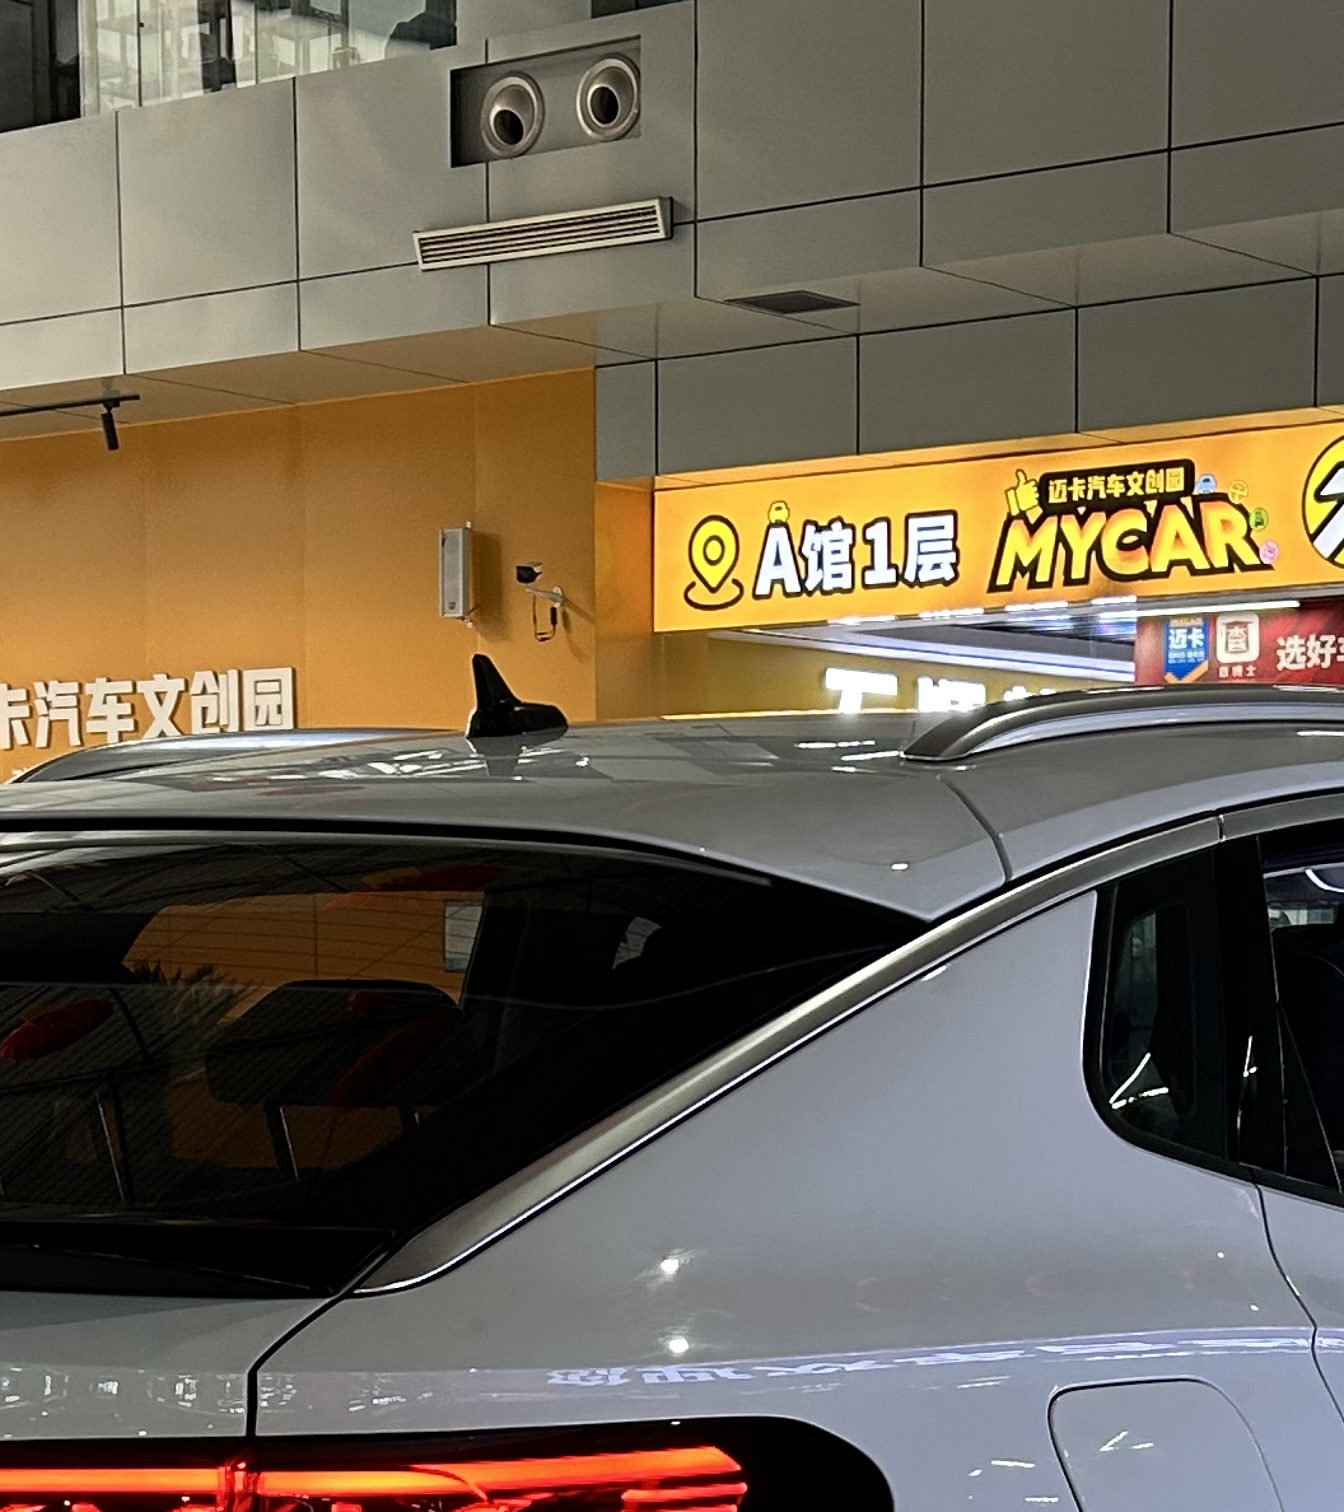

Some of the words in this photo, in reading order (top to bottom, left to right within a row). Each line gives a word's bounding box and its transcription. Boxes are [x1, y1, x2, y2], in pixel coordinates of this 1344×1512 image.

[1048, 466, 1186, 504] 迈卡汽车文创园
[756, 514, 958, 596] A馆1层
[993, 499, 1264, 590] MYCAR
[1168, 627, 1205, 650] 迈卡
